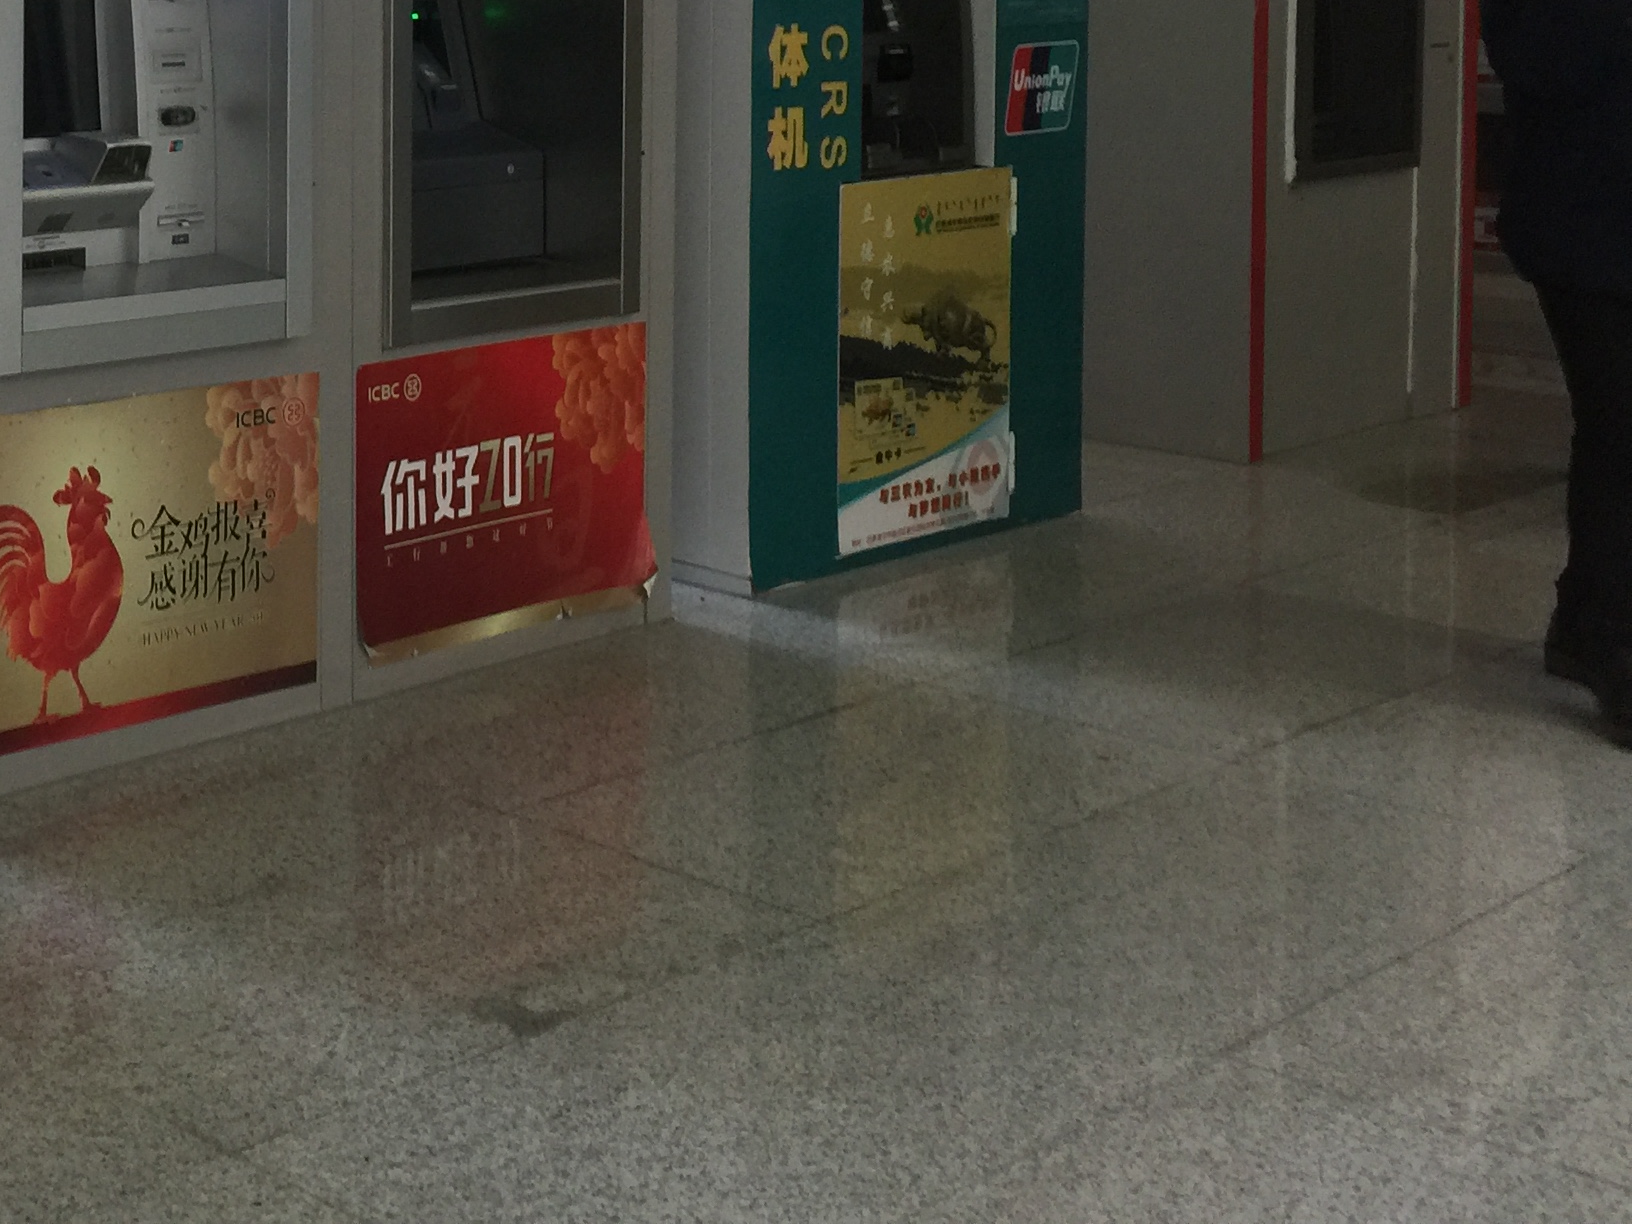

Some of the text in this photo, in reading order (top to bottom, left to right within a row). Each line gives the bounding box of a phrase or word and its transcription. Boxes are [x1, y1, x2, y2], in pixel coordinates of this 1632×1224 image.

[819, 24, 849, 170] CRS
[1014, 65, 1071, 97] UnionPay
[368, 382, 400, 403] ICBC
[236, 406, 276, 428] ICBC
[136, 498, 271, 560] 金鸡报喜
[138, 541, 274, 610] 感谢有你
